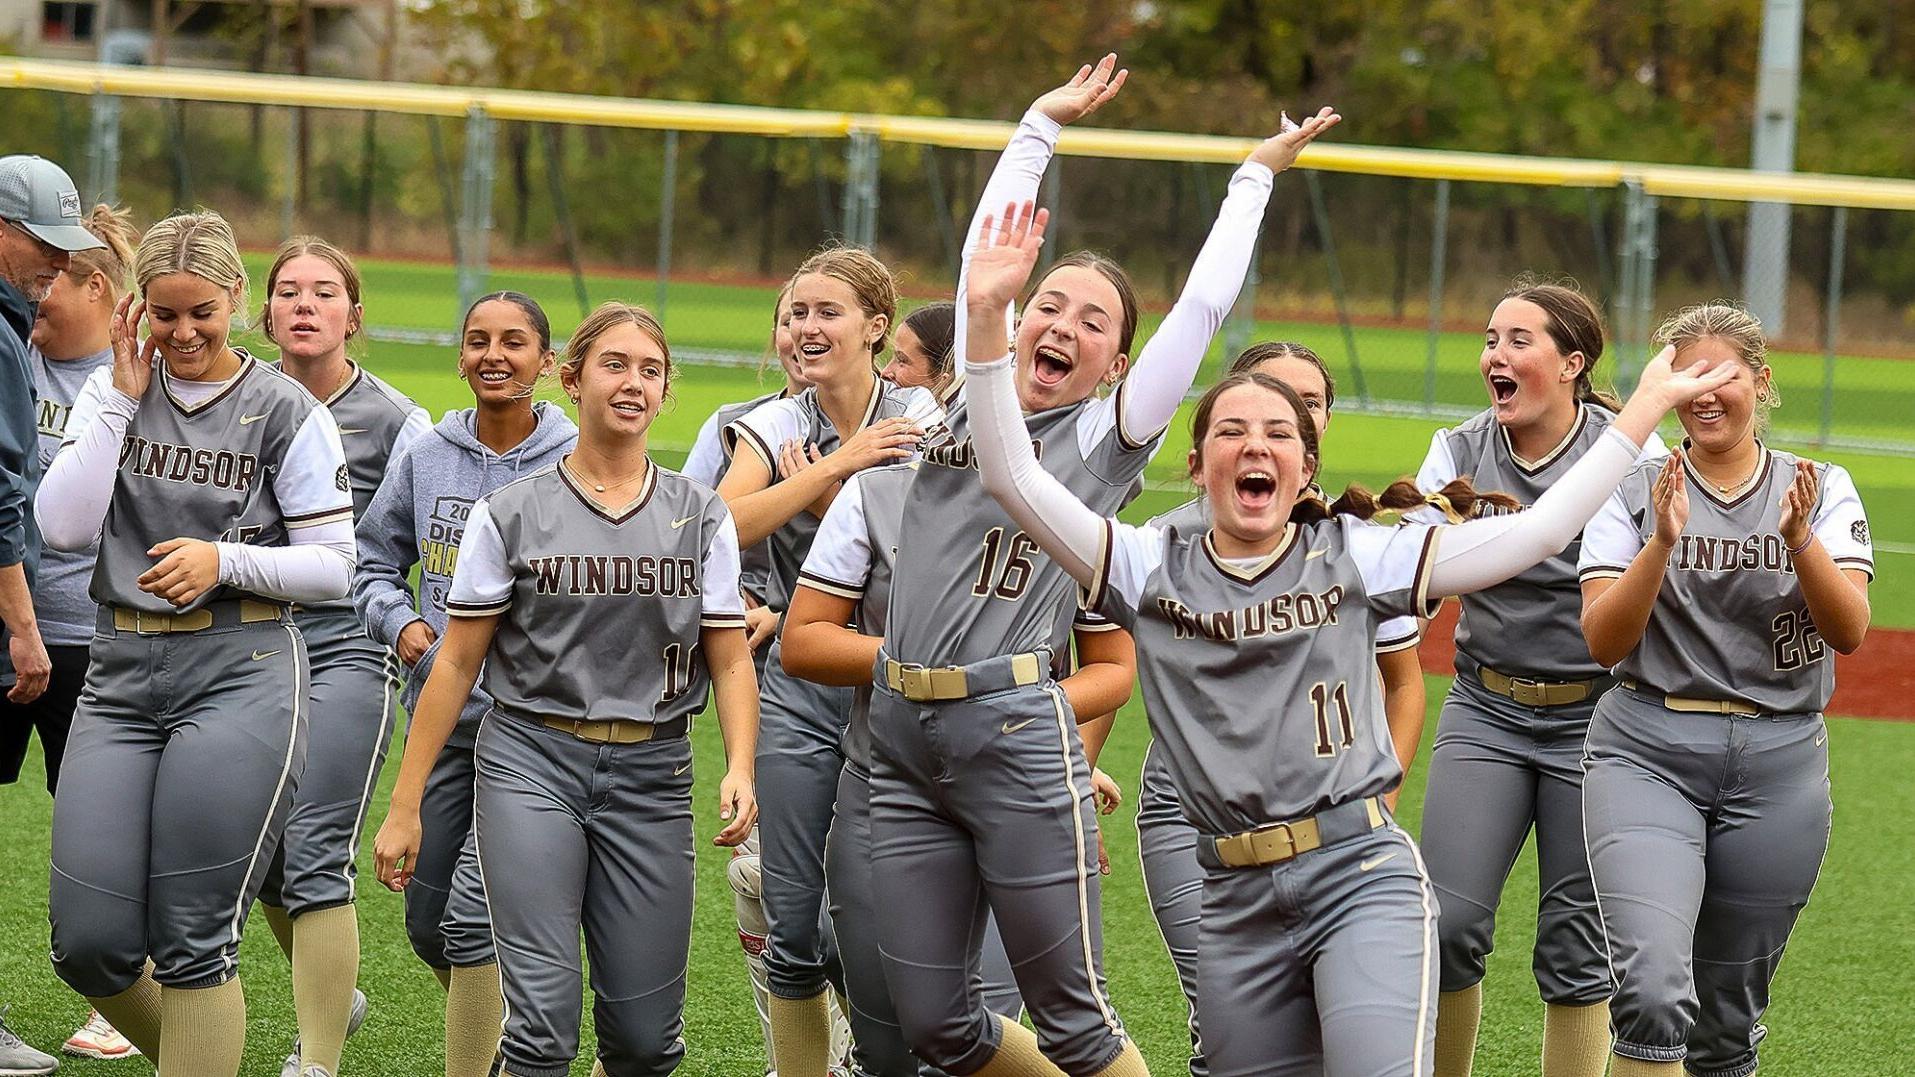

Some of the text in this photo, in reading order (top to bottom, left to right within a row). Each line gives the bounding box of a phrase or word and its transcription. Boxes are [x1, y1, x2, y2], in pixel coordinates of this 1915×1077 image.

[528, 555, 701, 598] WINDSOR
[971, 527, 1040, 601] 16
[1666, 533, 1796, 575] INDSO
[1772, 604, 1826, 671] 22
[1308, 681, 1355, 758] 11
